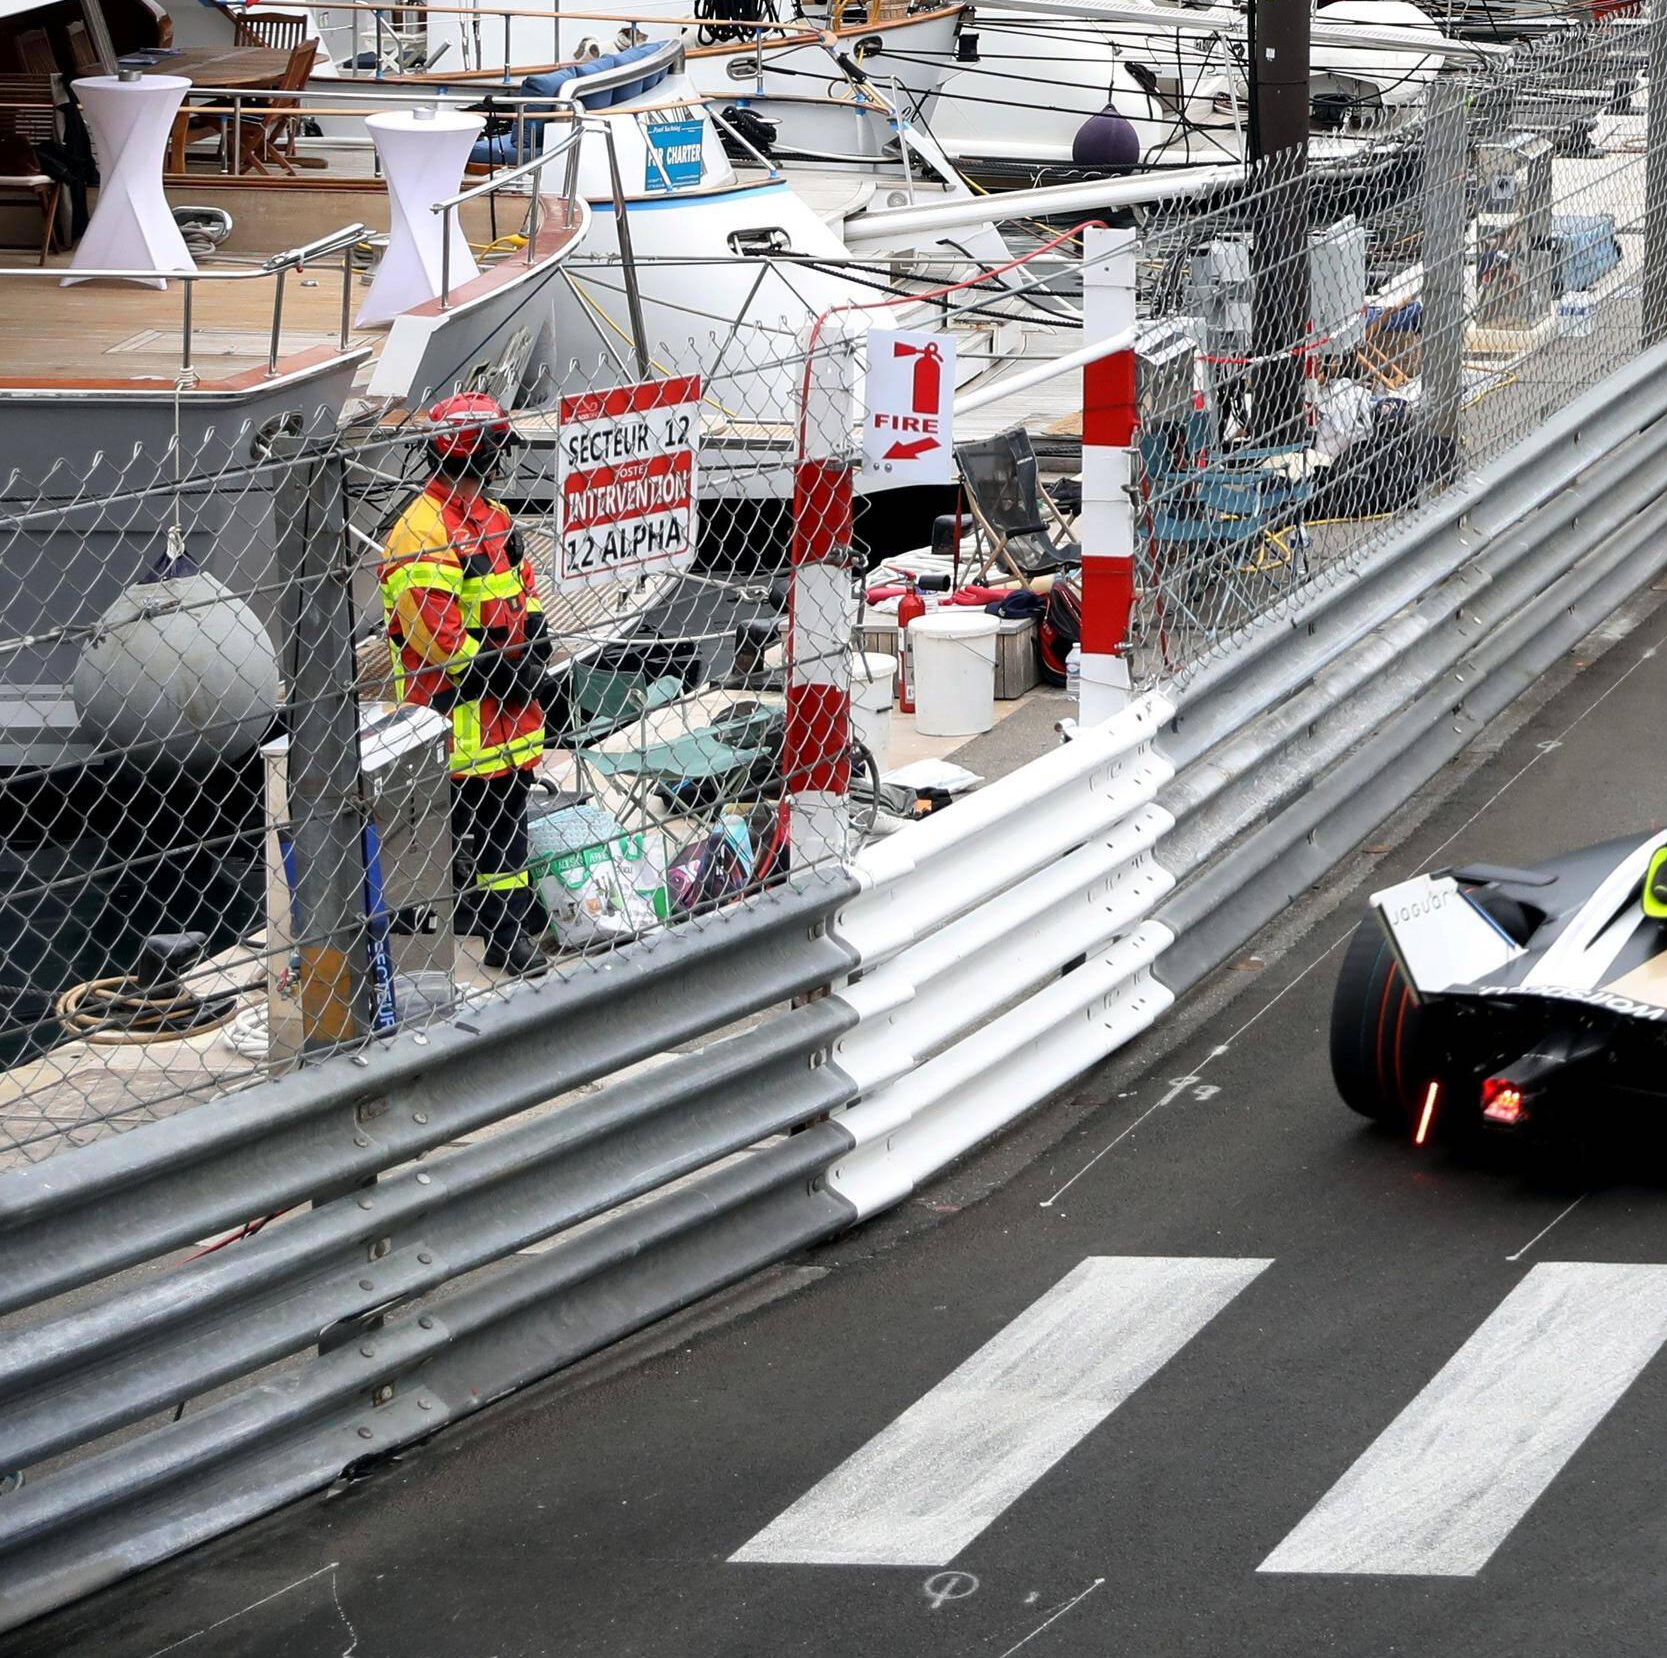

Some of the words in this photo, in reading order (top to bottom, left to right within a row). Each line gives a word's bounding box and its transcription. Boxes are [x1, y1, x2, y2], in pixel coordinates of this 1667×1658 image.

[666, 144, 701, 165] CHARTER
[568, 423, 649, 467] SECTEUR
[664, 415, 690, 447] 12
[874, 413, 939, 434] FIRE
[568, 470, 687, 523] INTERVENTION
[567, 536, 594, 571] 12
[601, 517, 681, 563] ALPHA
